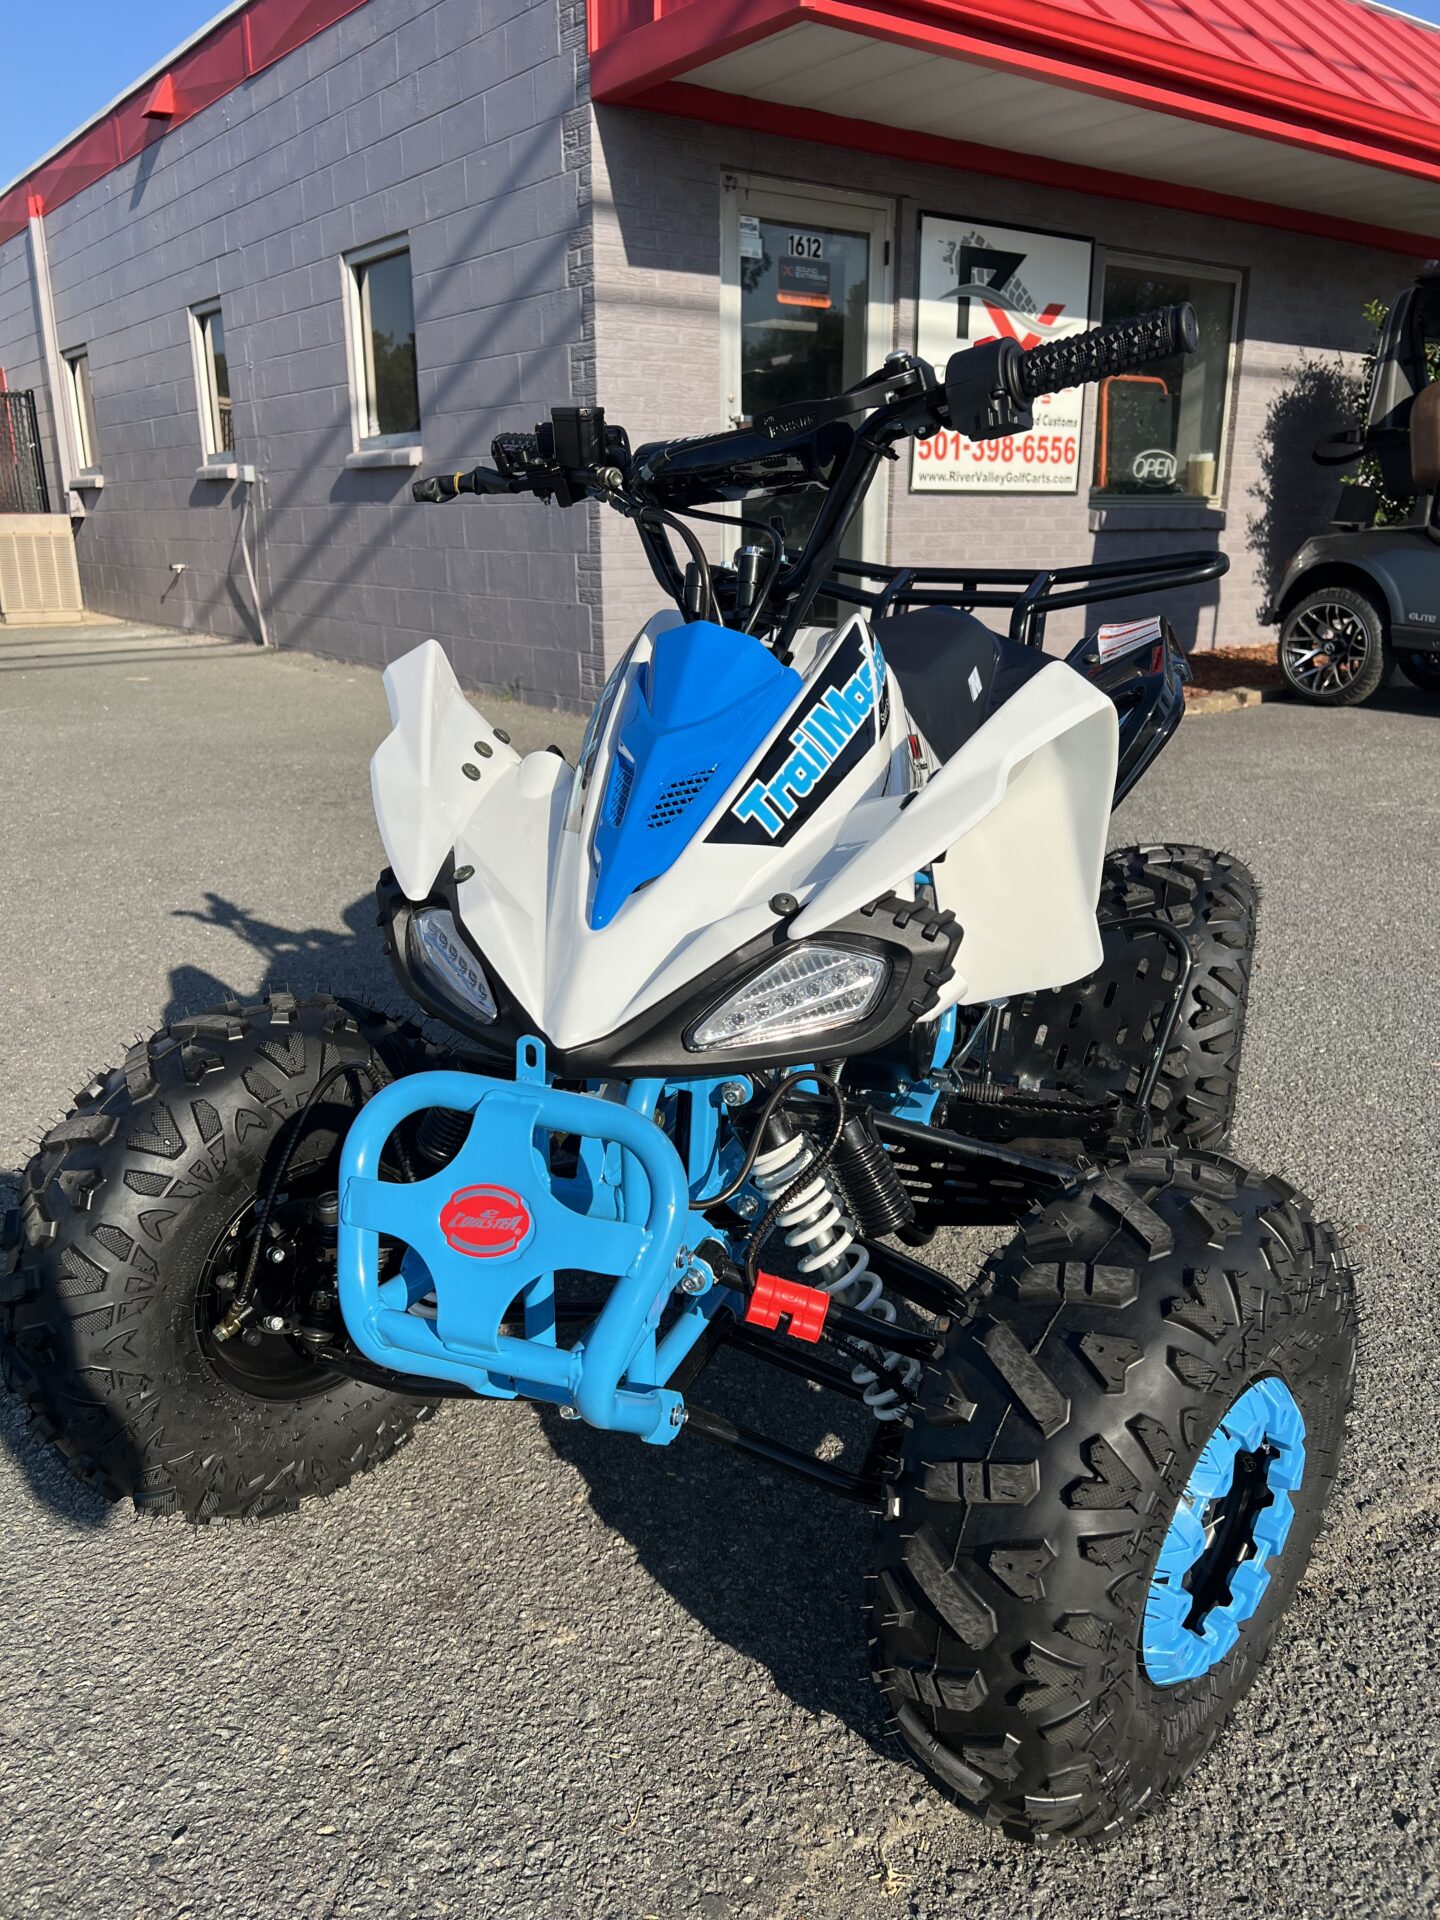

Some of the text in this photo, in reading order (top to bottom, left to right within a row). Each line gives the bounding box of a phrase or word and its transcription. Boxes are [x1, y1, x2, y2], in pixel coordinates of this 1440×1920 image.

[789, 235, 822, 259] 1612
[1043, 414, 1078, 428] Customs
[918, 431, 1076, 465] 501-398-6556
[918, 471, 1073, 485] www.RiverValleyGolfCarts.com
[1133, 457, 1177, 479] OPEN
